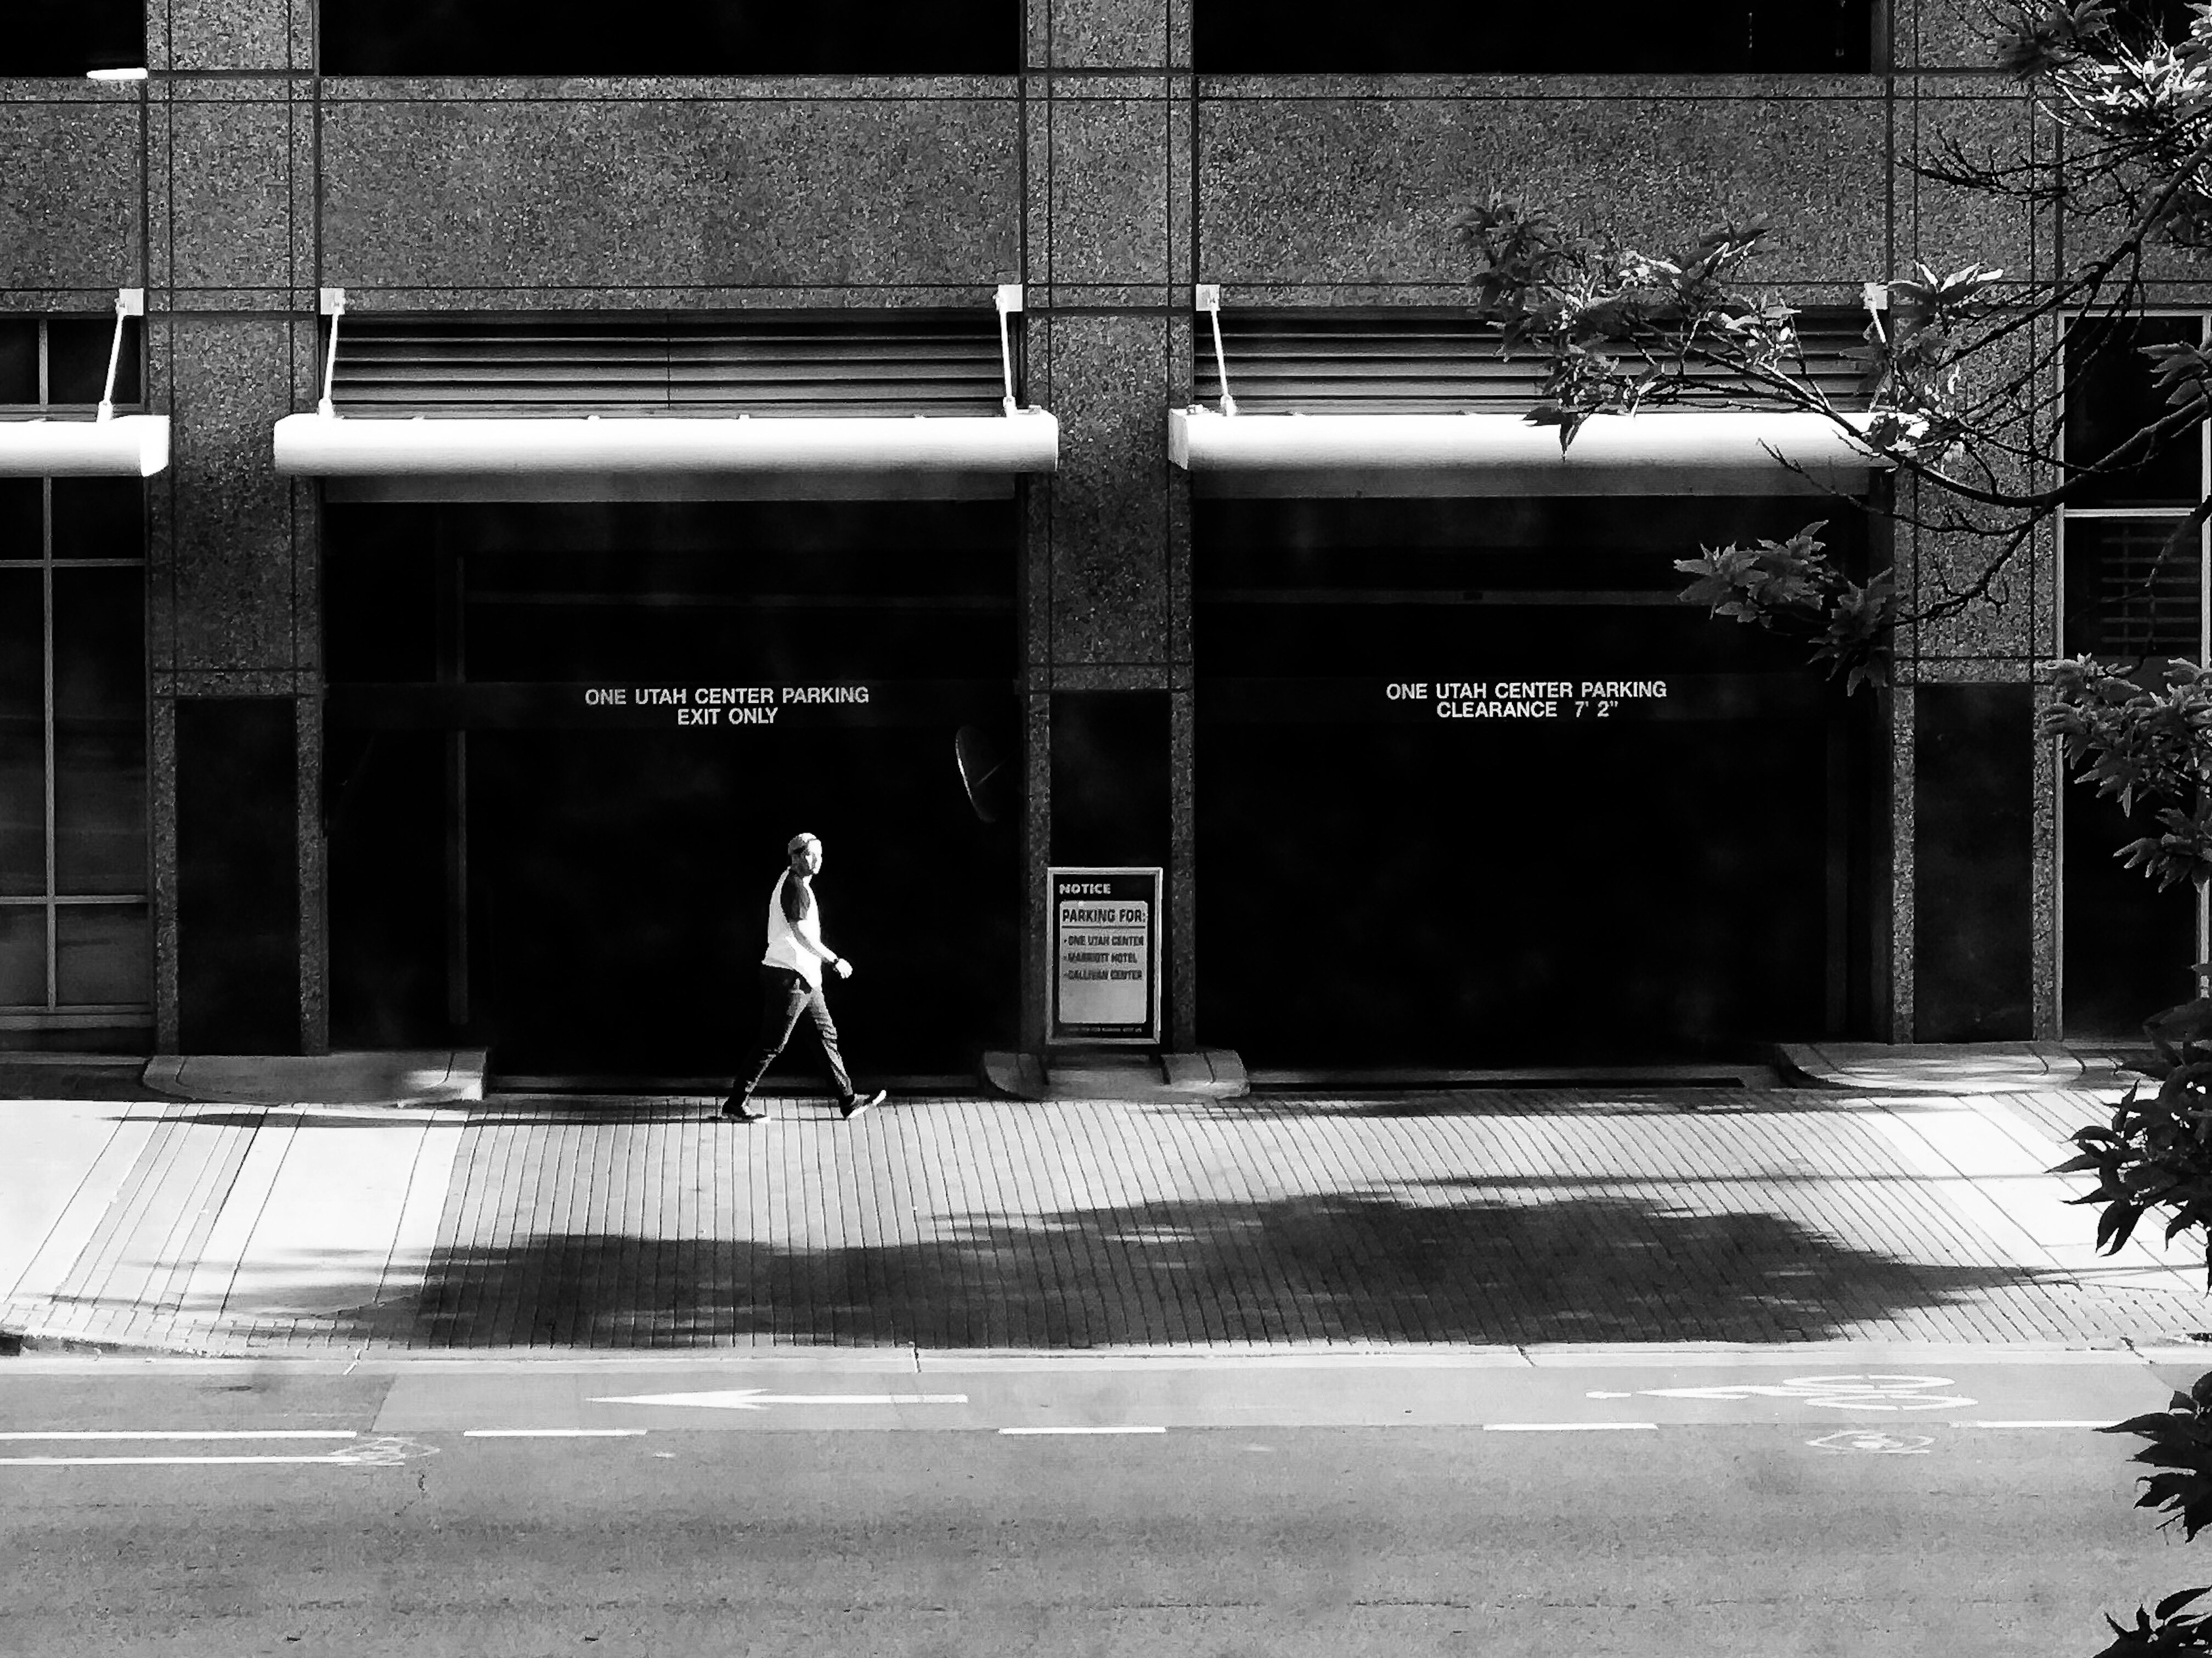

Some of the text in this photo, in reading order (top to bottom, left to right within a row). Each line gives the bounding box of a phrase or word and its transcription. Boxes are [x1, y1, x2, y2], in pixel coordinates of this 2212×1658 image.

[585, 687, 869, 705] ONE UTAH CENTER PARKING
[1386, 681, 1667, 700] ONE UTAH CENTER PARKING
[678, 706, 778, 725] EXIT ONLY
[1436, 700, 1558, 718] CLEARANCE
[1575, 701, 1589, 718] 7'
[1059, 884, 1111, 895] NOTICE
[1062, 908, 1146, 923] PARKING FOR:
[1068, 936, 1144, 946] ONE UTAH CENTER
